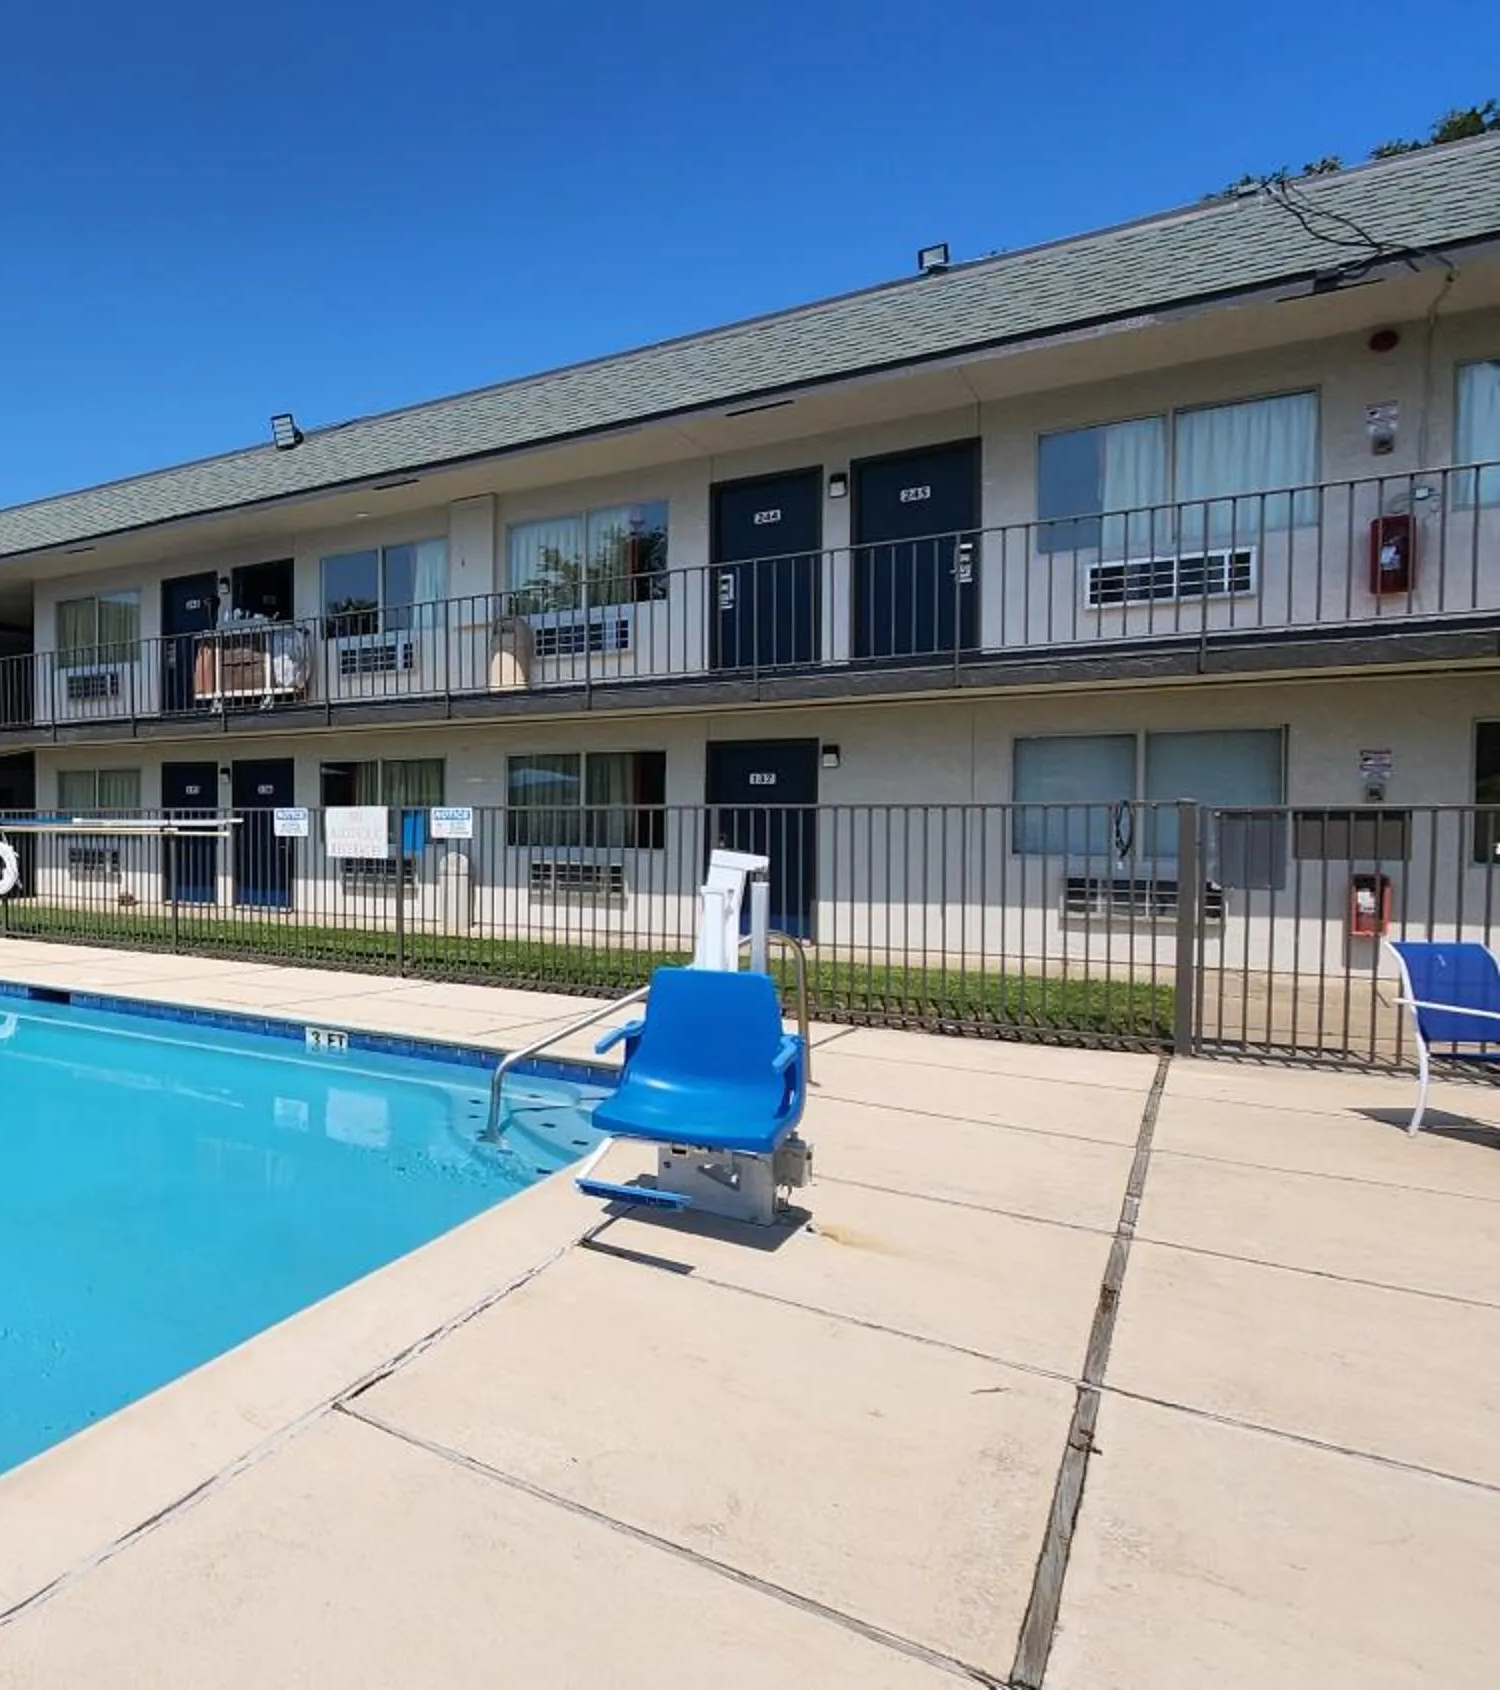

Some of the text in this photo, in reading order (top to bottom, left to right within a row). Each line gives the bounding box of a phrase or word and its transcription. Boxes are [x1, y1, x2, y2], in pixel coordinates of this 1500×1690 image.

[900, 486, 930, 502] 245
[753, 509, 781, 524] 244
[434, 810, 469, 820] NOTICE
[311, 1030, 346, 1047] 3 FT
